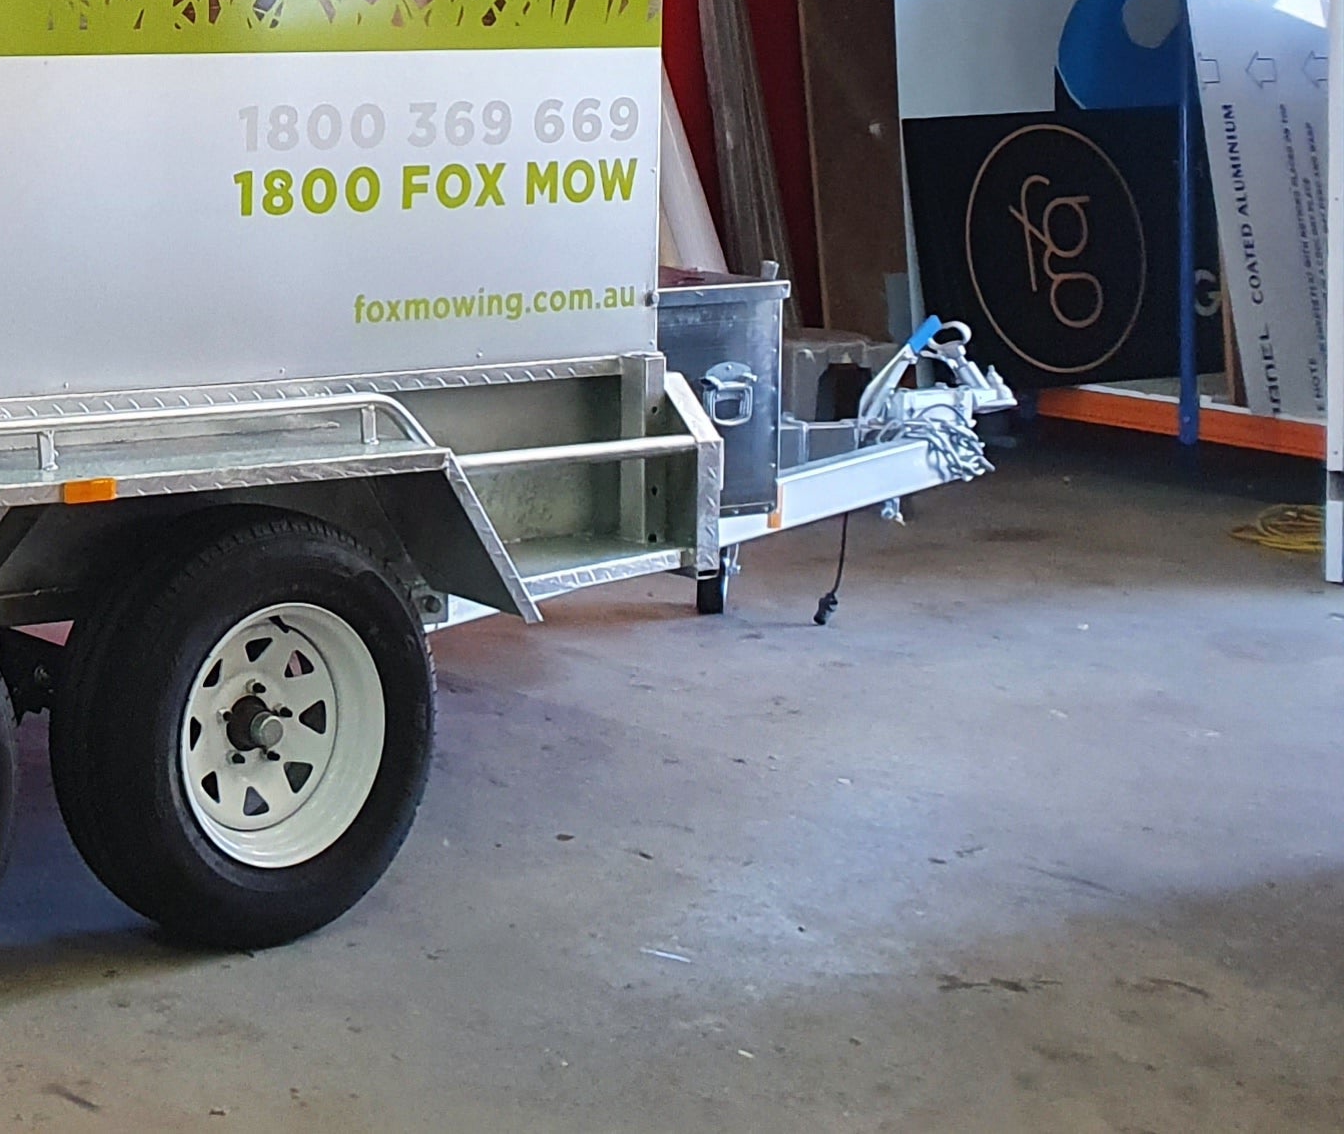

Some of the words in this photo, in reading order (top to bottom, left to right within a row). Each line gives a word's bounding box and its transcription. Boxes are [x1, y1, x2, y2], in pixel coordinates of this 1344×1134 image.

[238, 103, 386, 151] 1800
[407, 100, 513, 148] 369
[533, 97, 640, 144] 669
[233, 166, 380, 217] 1800
[401, 163, 508, 210] FOX
[526, 158, 639, 205] MOW
[1221, 104, 1250, 217] ALUMINIUM
[1241, 224, 1264, 305] COATED
[353, 285, 636, 324] foxmowing.com.au
